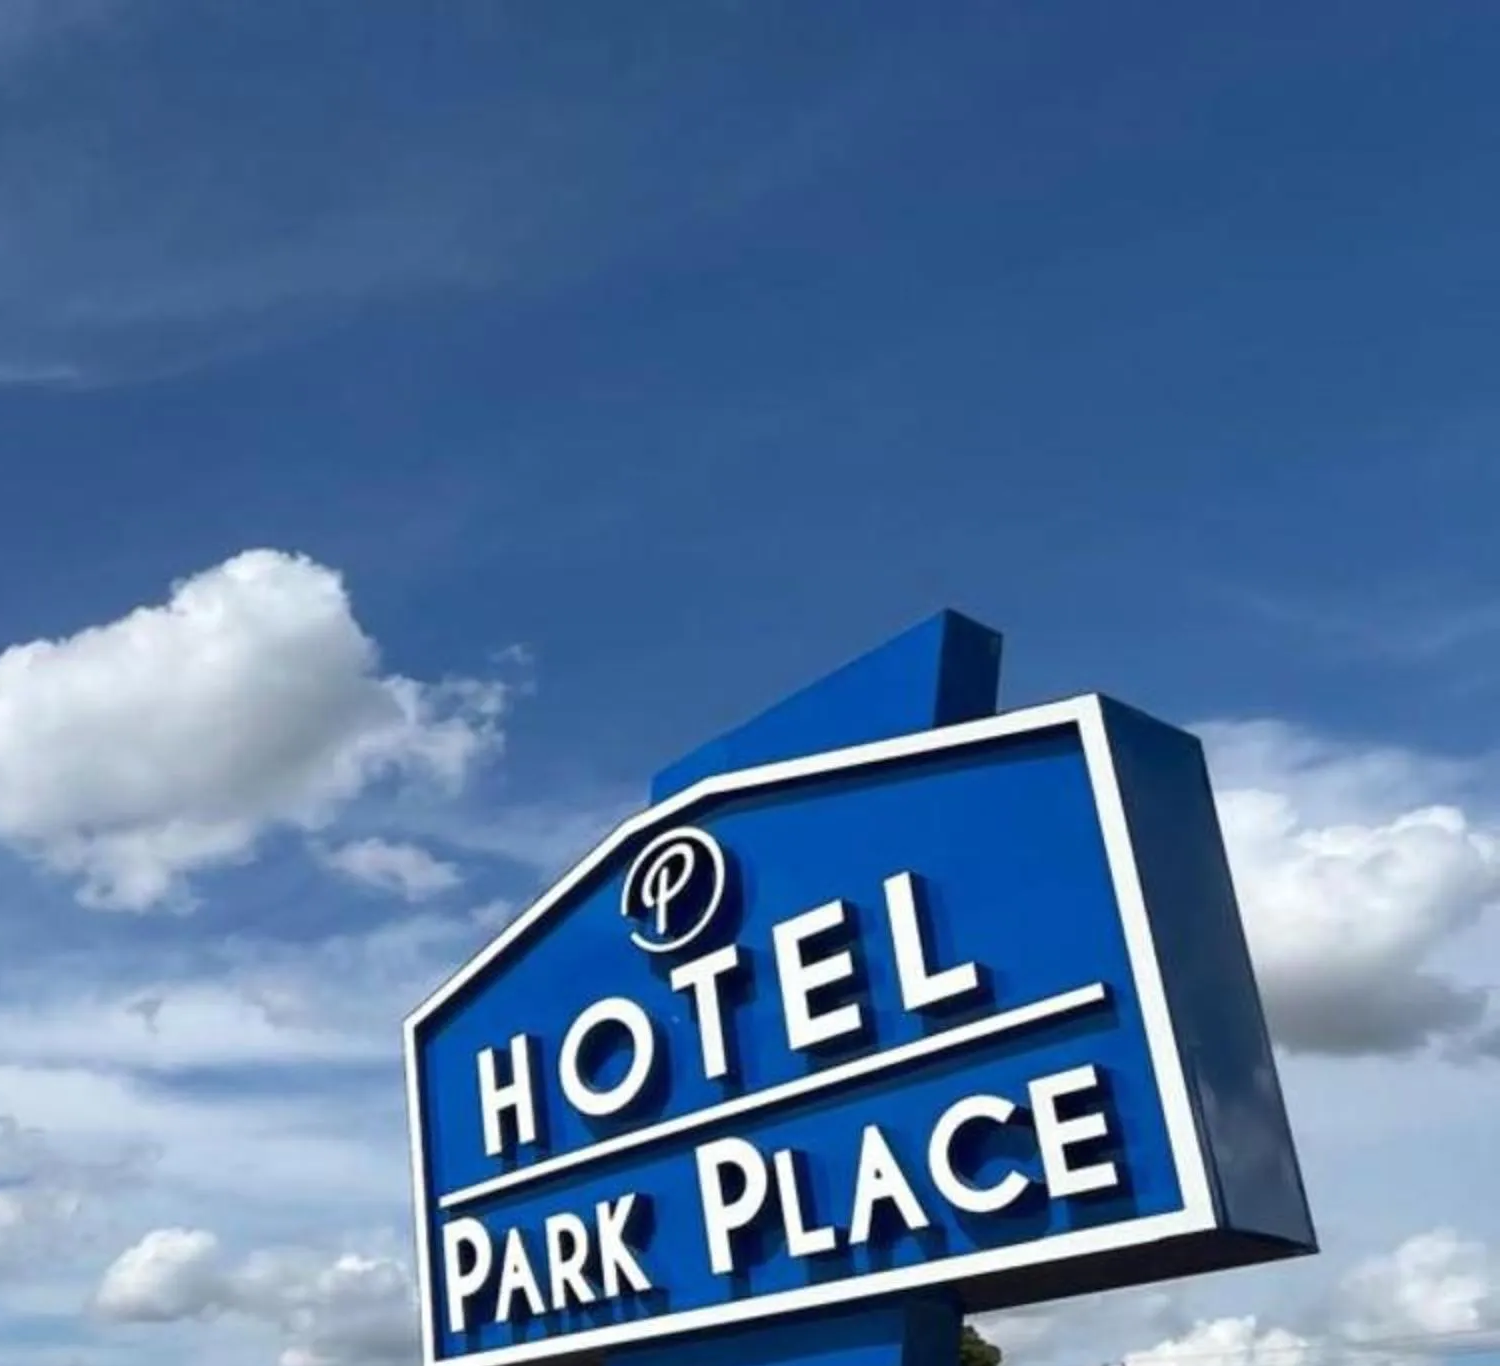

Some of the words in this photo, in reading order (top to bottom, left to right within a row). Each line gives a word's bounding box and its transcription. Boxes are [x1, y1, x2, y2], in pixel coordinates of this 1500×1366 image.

[479, 872, 977, 1154] HOTEL
[444, 1194, 651, 1332] PARK
[697, 1065, 1117, 1274] PLACE
